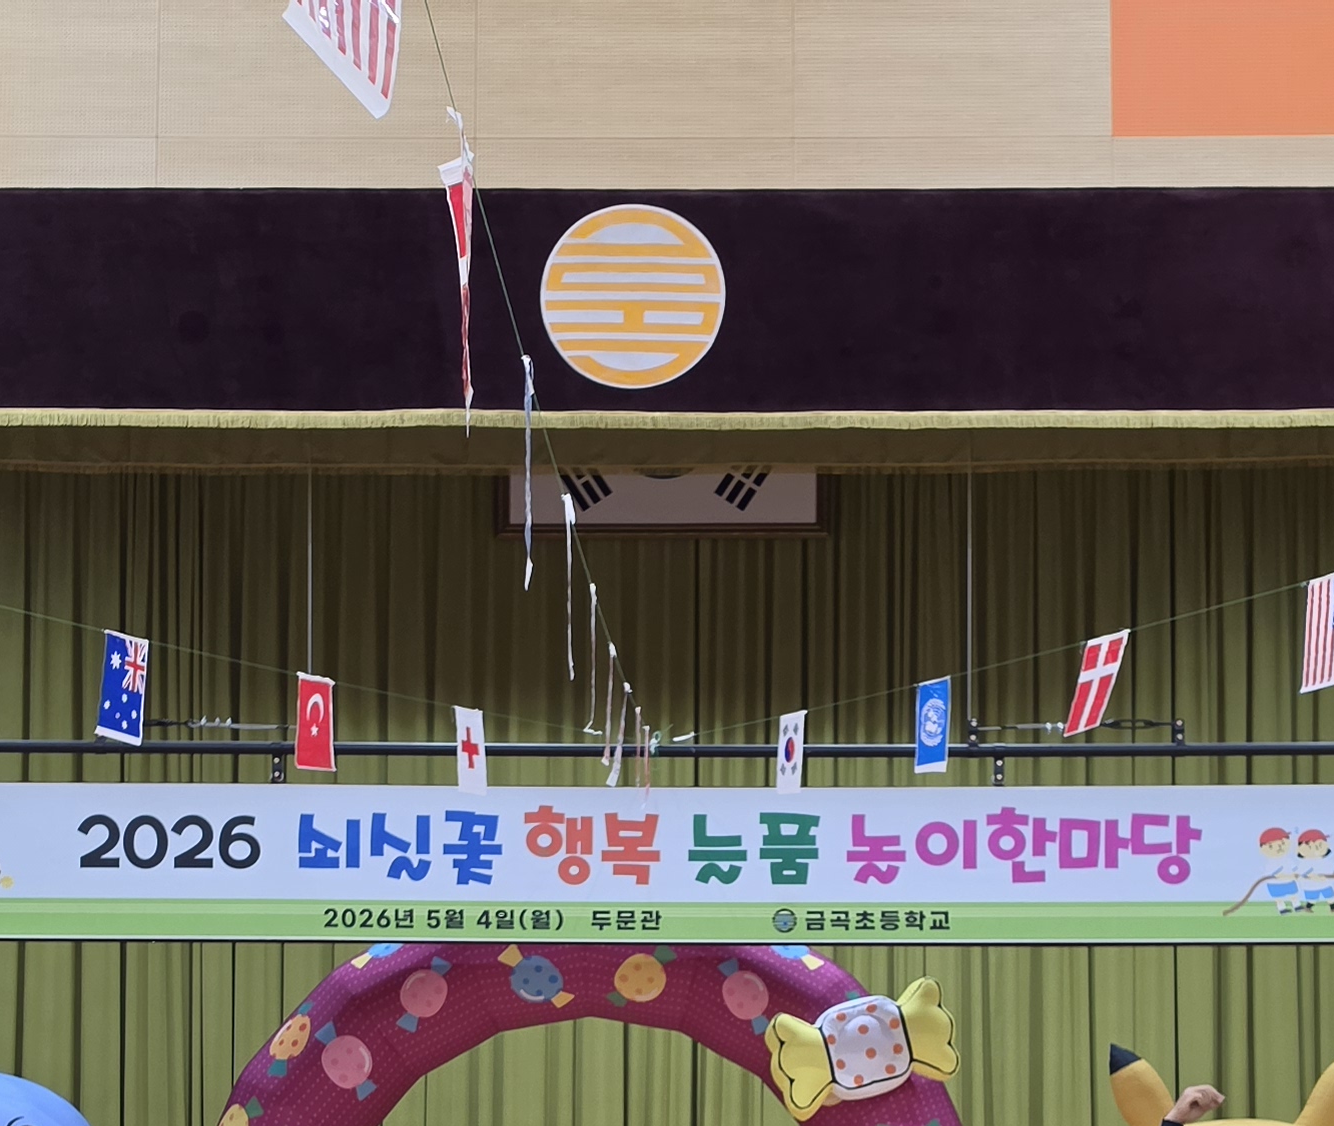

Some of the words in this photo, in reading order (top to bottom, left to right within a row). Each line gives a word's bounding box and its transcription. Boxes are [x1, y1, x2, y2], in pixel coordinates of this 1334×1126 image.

[78, 814, 261, 870] 2026
[524, 805, 661, 886] 행복
[687, 812, 821, 885] 늘품
[846, 807, 1203, 885] 놀이한마당
[323, 908, 414, 930] 2026년
[427, 909, 464, 930] 5월
[476, 908, 564, 932] 4일(월)
[591, 910, 662, 931] 두문관
[805, 910, 951, 931] 금곡초등학교
